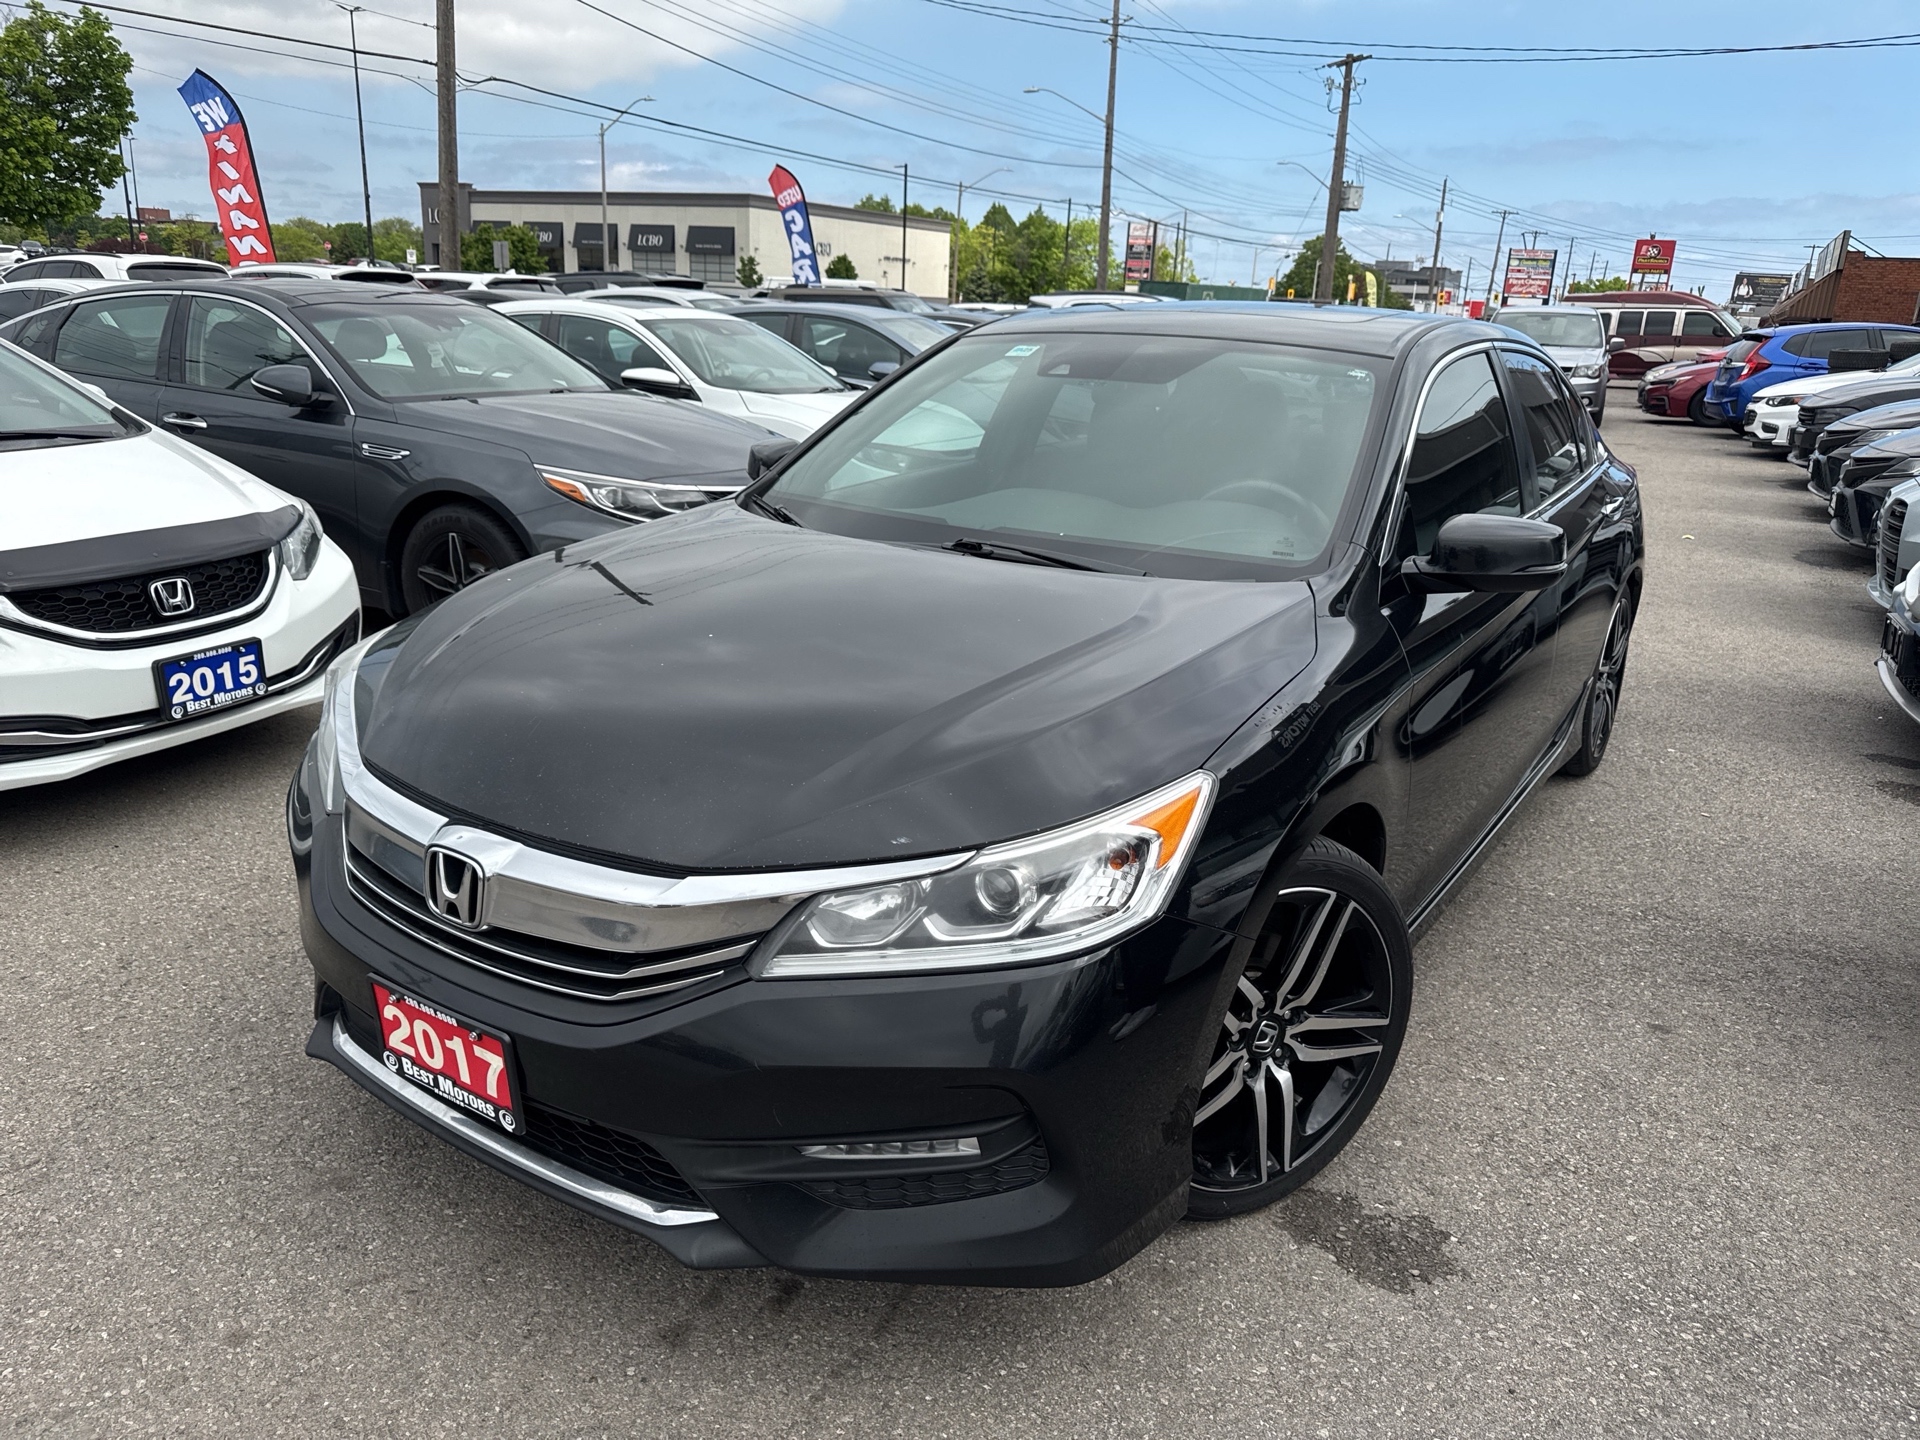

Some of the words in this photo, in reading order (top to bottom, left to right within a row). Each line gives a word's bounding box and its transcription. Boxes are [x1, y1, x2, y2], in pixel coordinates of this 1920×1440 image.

[637, 233, 663, 247] LCBO
[168, 654, 259, 705] 2015
[186, 698, 212, 712] BEST
[213, 686, 254, 705] MOTORS
[383, 1004, 505, 1099] 2017
[401, 1056, 434, 1089] BEST
[437, 1075, 496, 1118] MOTORS
